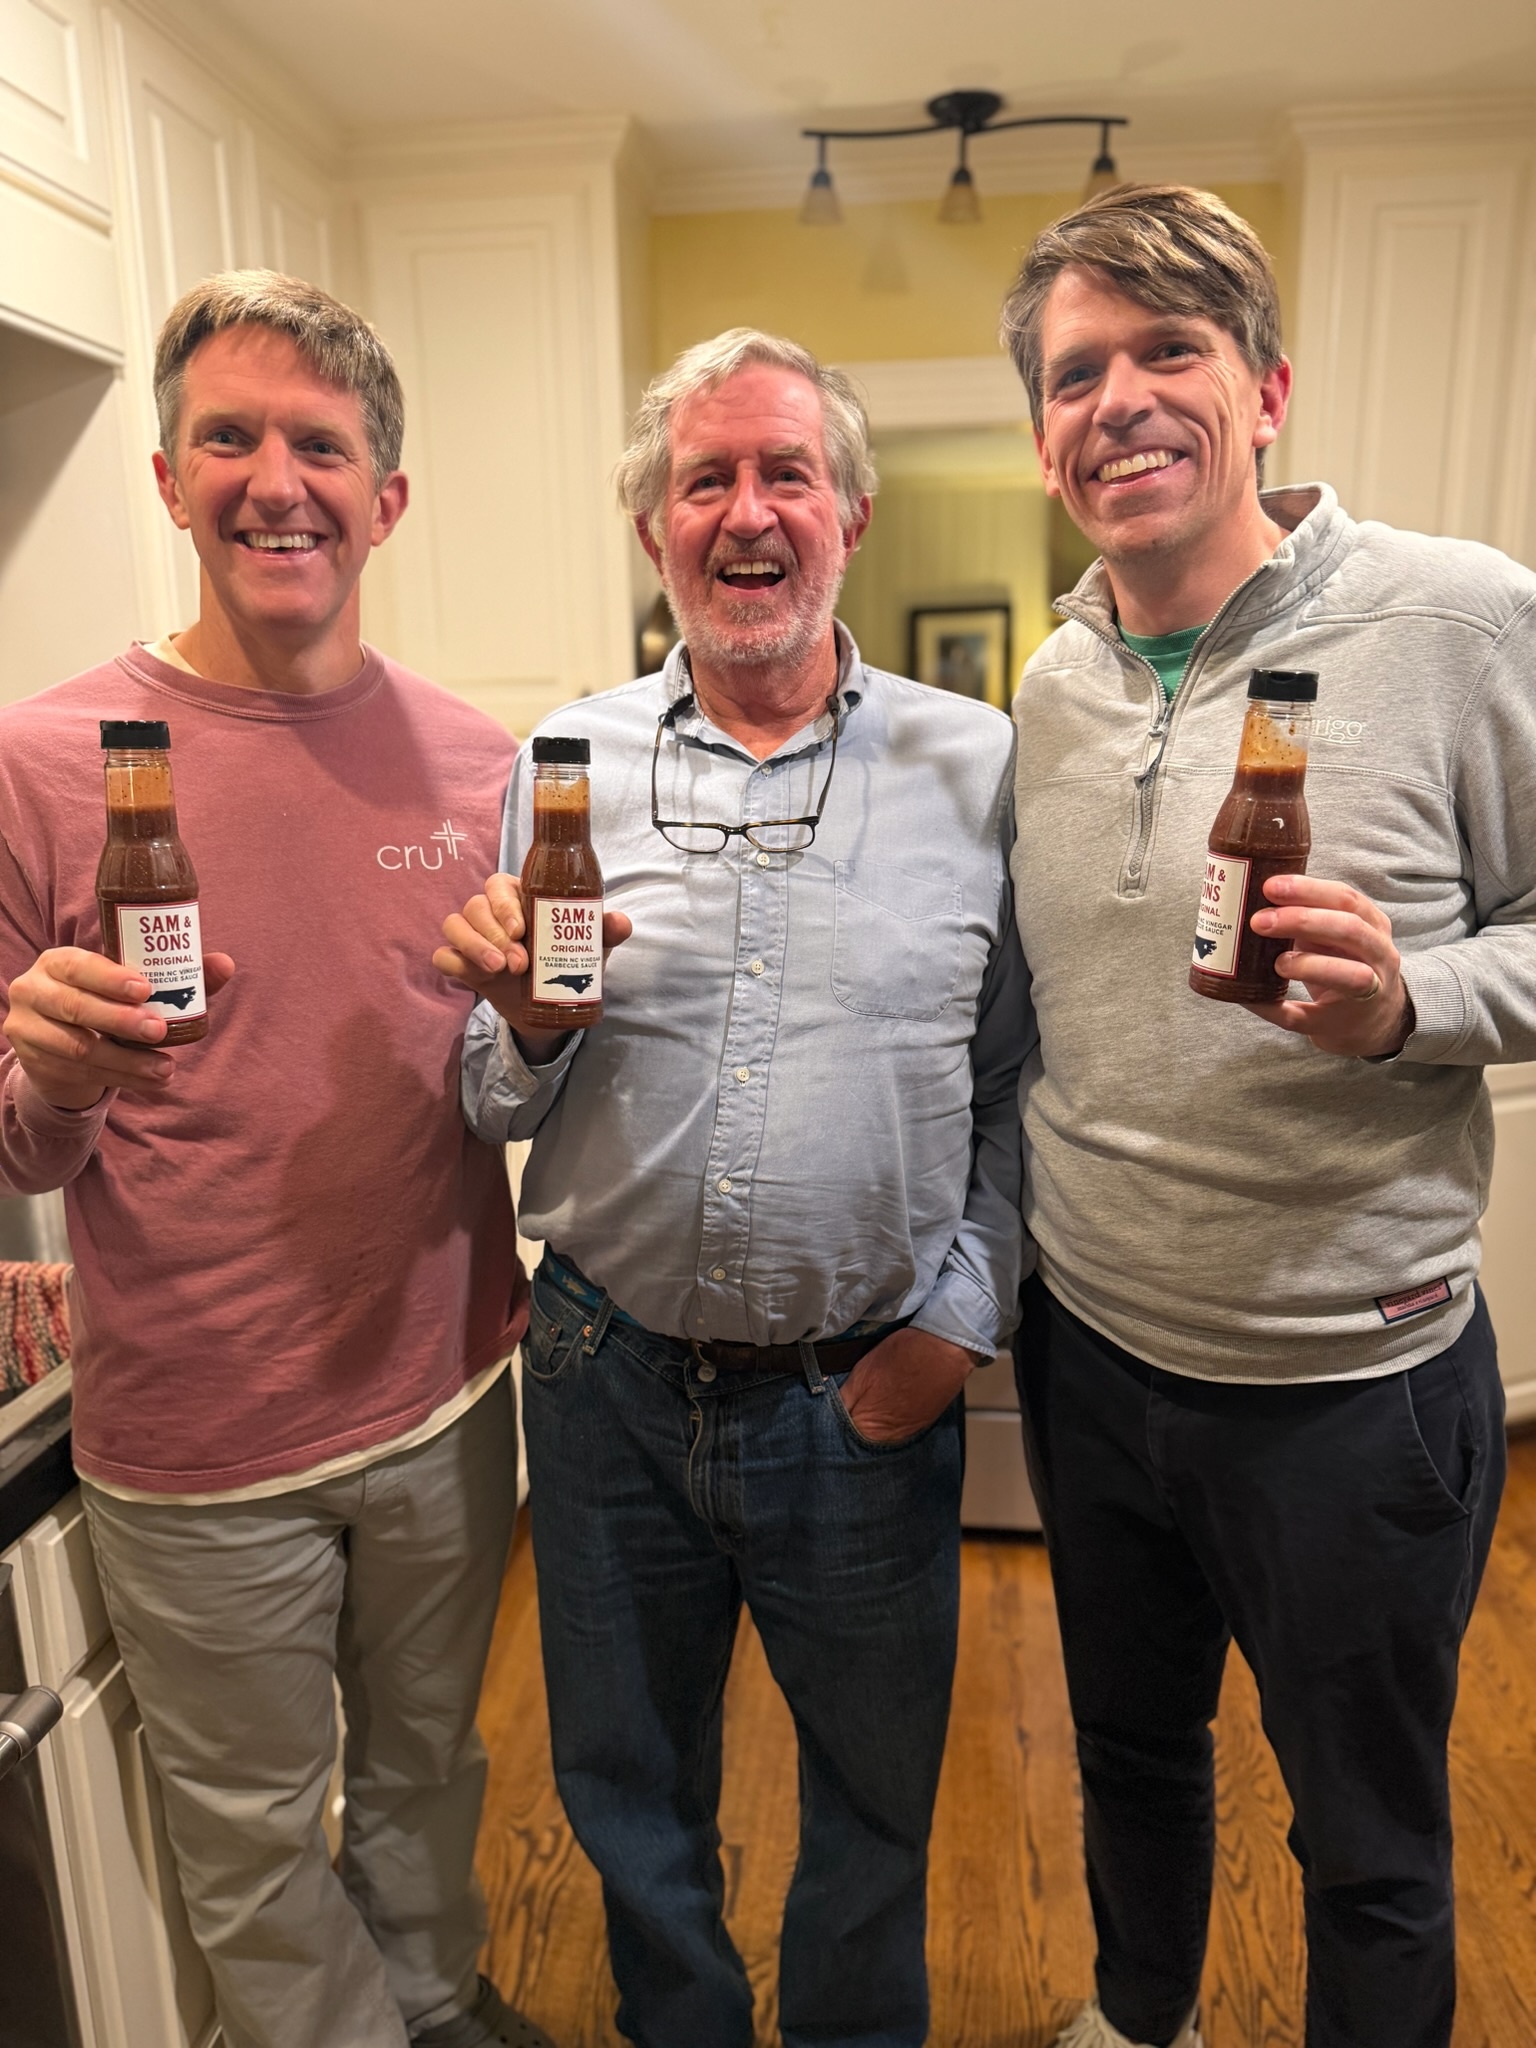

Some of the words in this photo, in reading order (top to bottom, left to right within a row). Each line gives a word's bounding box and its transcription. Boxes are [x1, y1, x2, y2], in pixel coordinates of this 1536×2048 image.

[376, 845, 443, 870] cru
[1217, 869, 1226, 883] &
[551, 907, 585, 924] SAM
[588, 910, 595, 922] &
[139, 914, 180, 934] SAM
[183, 915, 192, 928] &
[1205, 927, 1224, 935] SAUCE
[1206, 920, 1232, 930] VINEGAR
[553, 924, 593, 941] SONS
[144, 932, 191, 953] SONS
[551, 945, 594, 953] ORIGINAL
[143, 955, 194, 967] ORIGINAL
[180, 973, 199, 982] SAUCE
